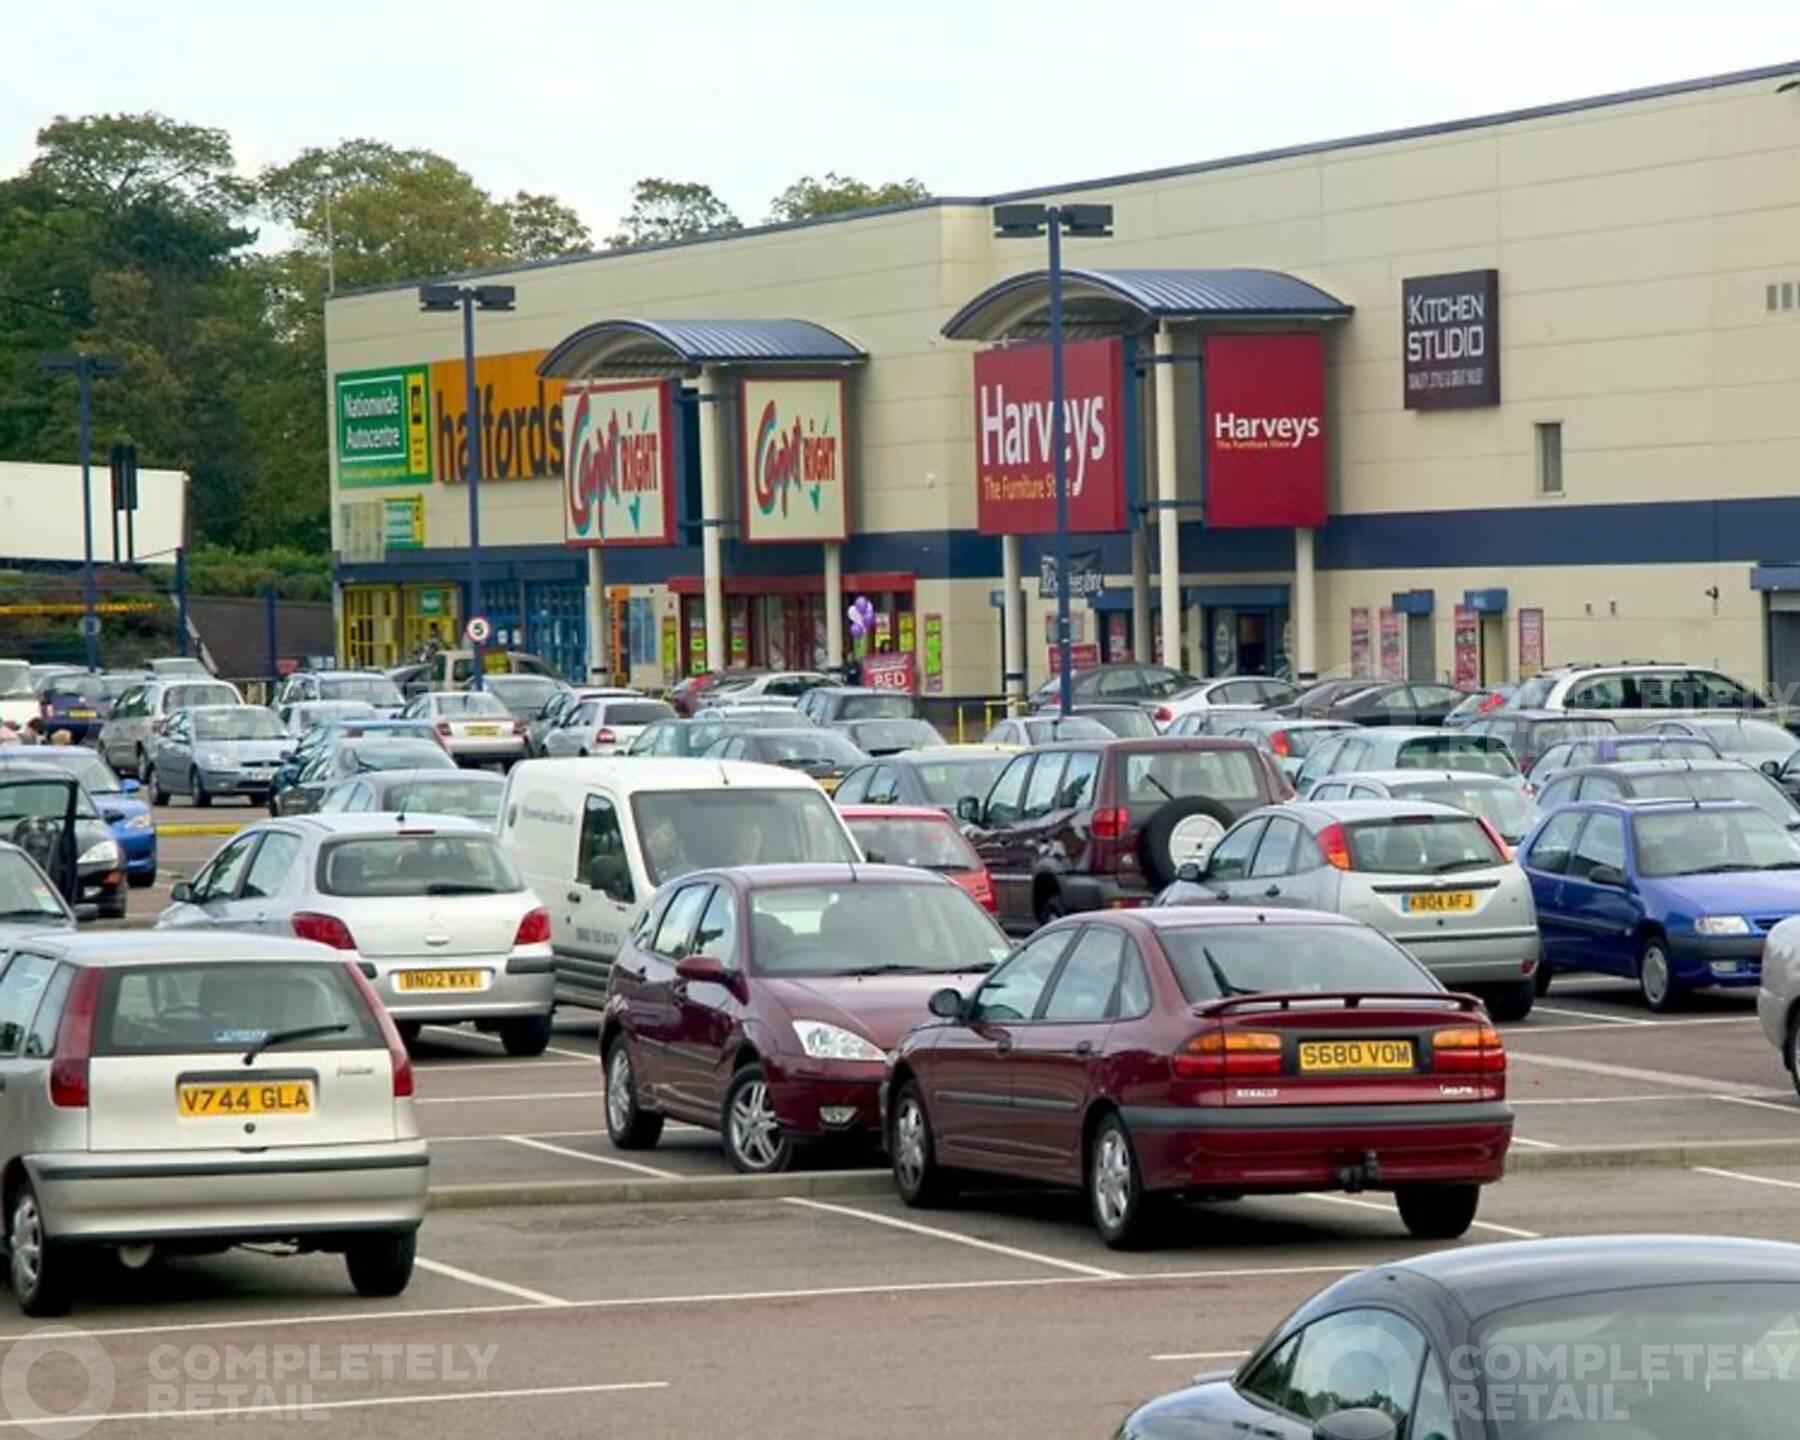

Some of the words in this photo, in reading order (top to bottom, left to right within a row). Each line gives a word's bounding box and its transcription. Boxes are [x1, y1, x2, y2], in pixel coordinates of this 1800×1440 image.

[1408, 295, 1484, 324] KITCHEN
[1407, 325, 1484, 361] STUDIO
[436, 380, 564, 480] halfords
[1215, 412, 1320, 448] Harveys
[1303, 1045, 1362, 1065] S680
[183, 1089, 250, 1112] V744
[260, 1086, 309, 1109] GLA
